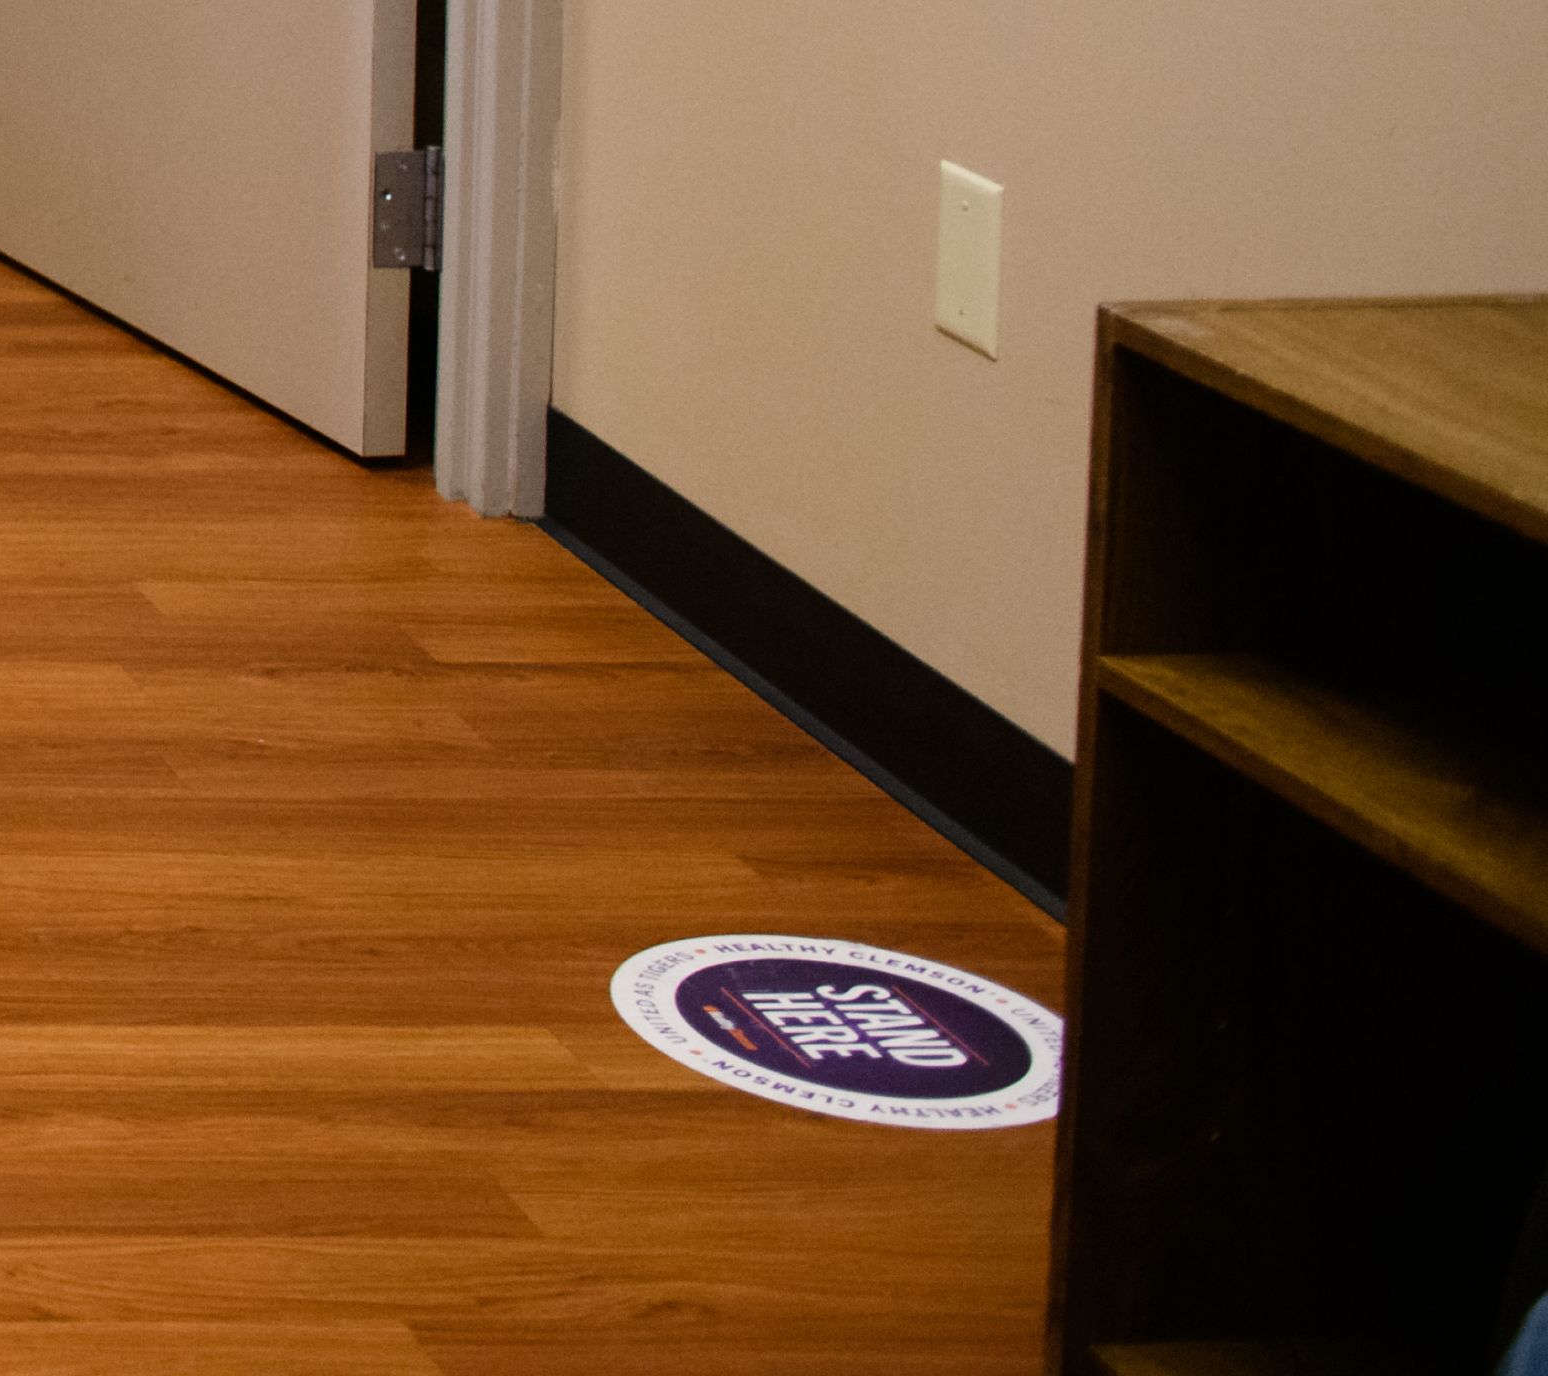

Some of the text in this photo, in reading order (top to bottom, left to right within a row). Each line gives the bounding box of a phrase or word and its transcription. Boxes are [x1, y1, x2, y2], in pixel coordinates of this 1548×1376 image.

[633, 951, 695, 1044] UNITED AS TIGERS
[714, 942, 987, 996] HEALTHY CLEMSON
[742, 992, 883, 1060] HERE
[815, 984, 969, 1067] STAND
[712, 1060, 1002, 1119] HEALTHY CLEMSON
